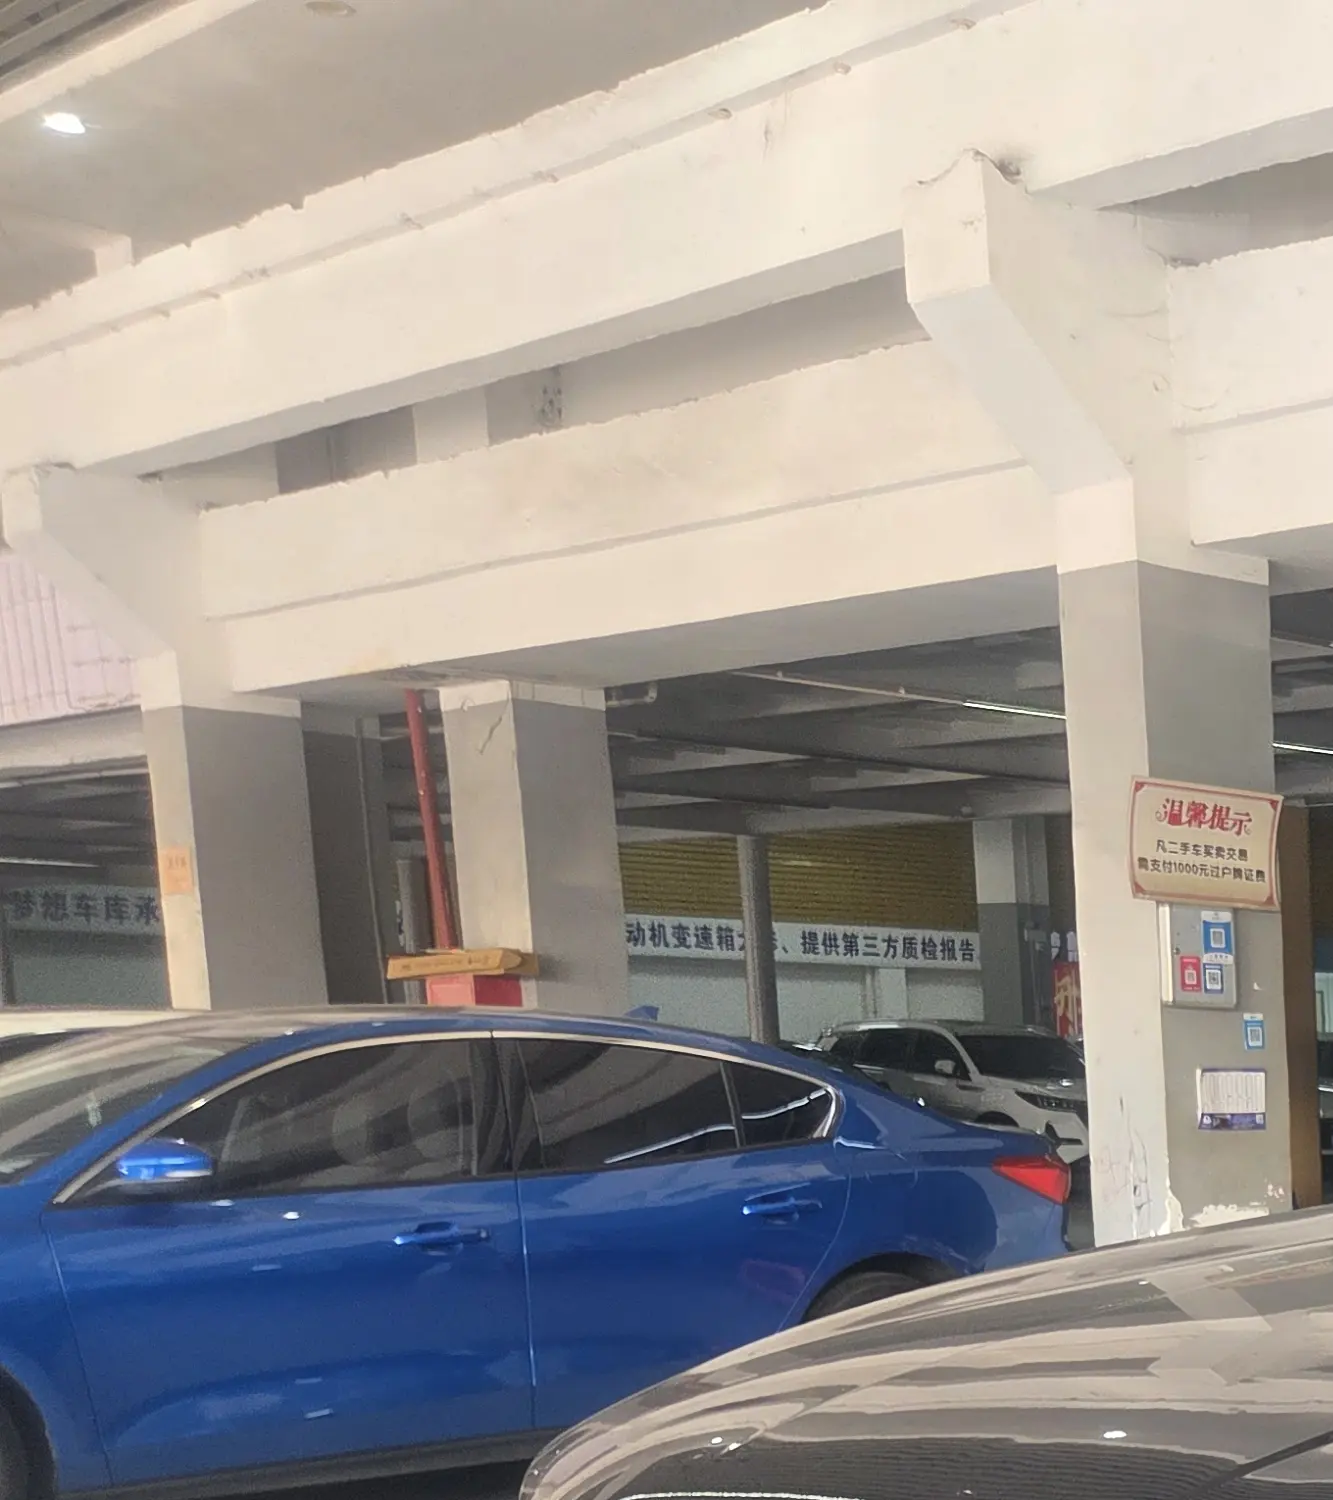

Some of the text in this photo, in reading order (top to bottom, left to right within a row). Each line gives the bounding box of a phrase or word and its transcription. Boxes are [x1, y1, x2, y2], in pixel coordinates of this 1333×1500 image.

[1155, 798, 1253, 836] 温馨提示
[1155, 839, 1249, 862] 凡二手车买卖交易
[625, 920, 976, 963] 动机变速箱、提供第三方质检报告
